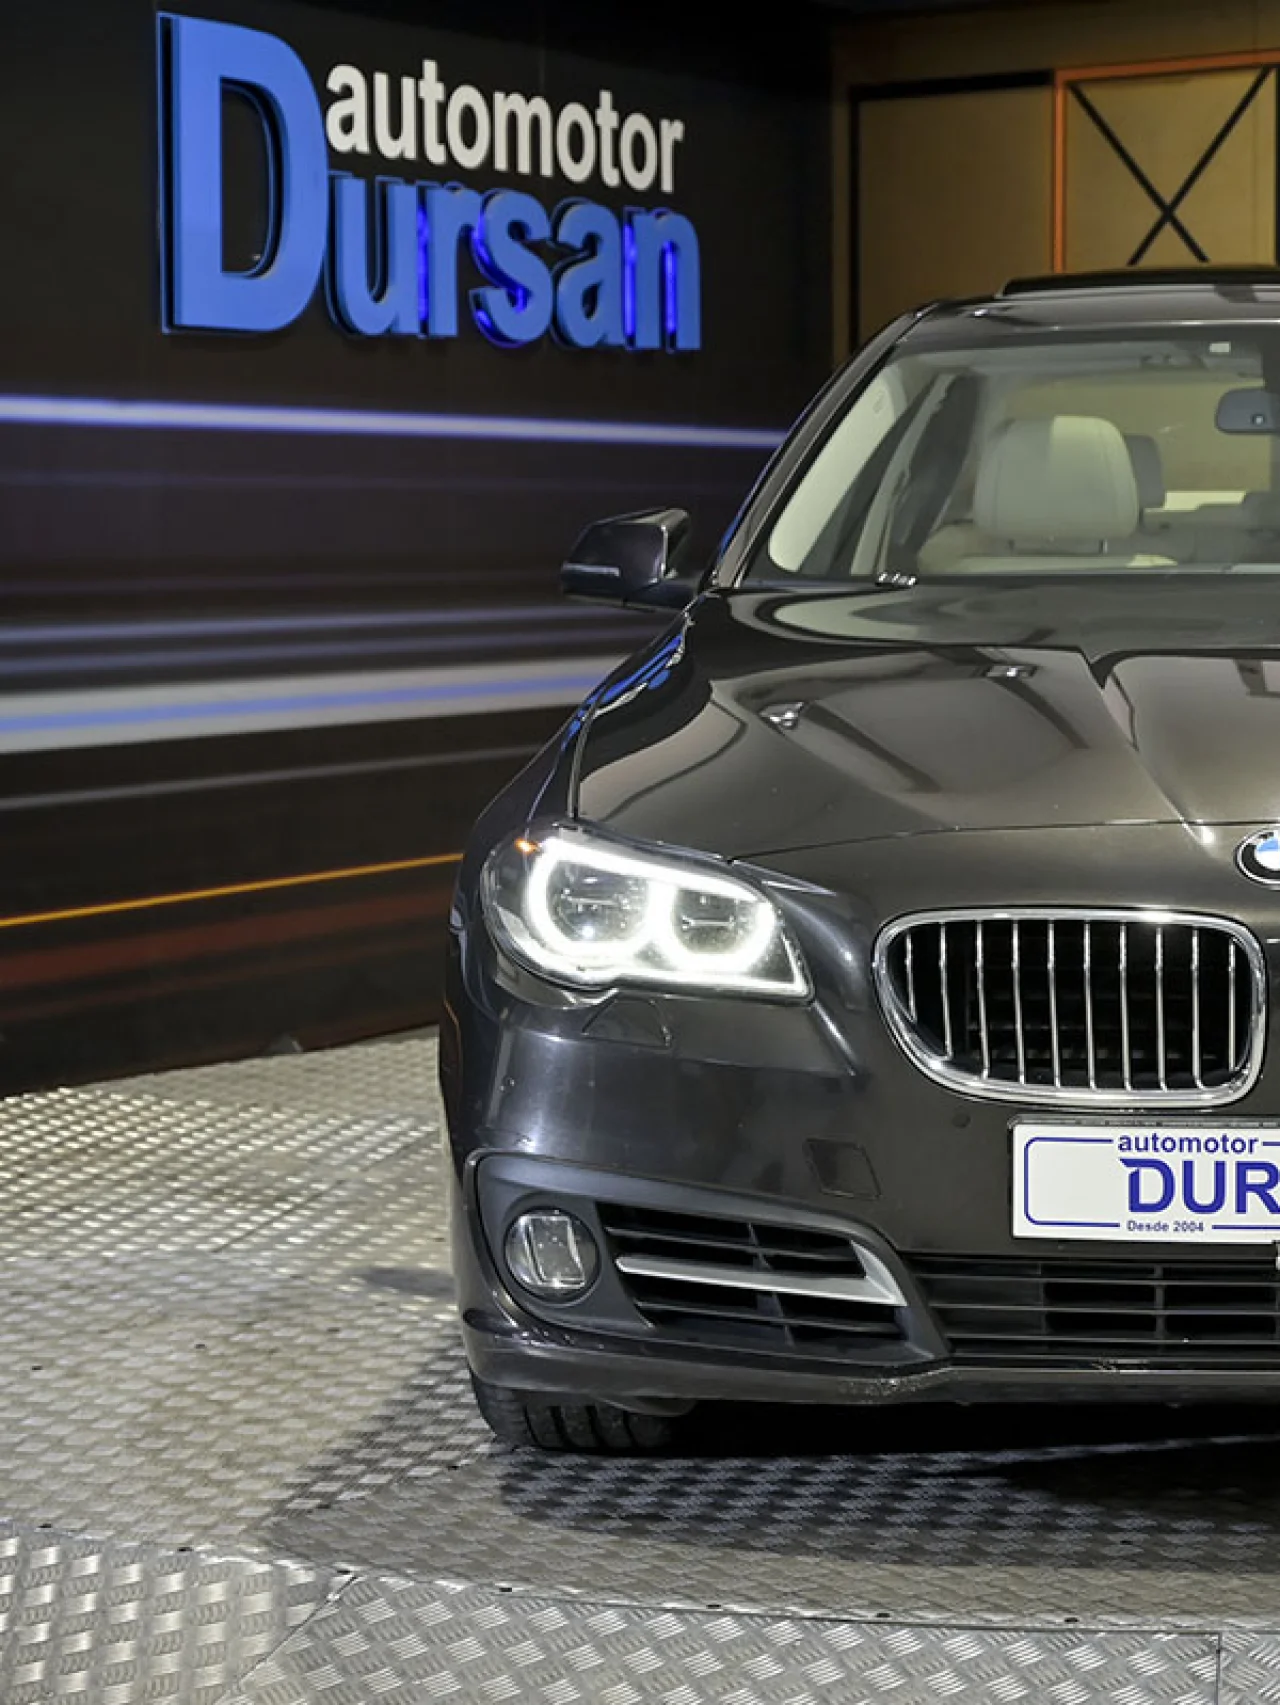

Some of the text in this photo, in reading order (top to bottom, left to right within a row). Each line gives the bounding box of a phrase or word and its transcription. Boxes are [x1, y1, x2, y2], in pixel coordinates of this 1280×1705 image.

[325, 59, 684, 193] automotor
[157, 11, 701, 352] Dursan
[1118, 1132, 1259, 1154] automotor
[1126, 1220, 1204, 1232] Desde 2004
